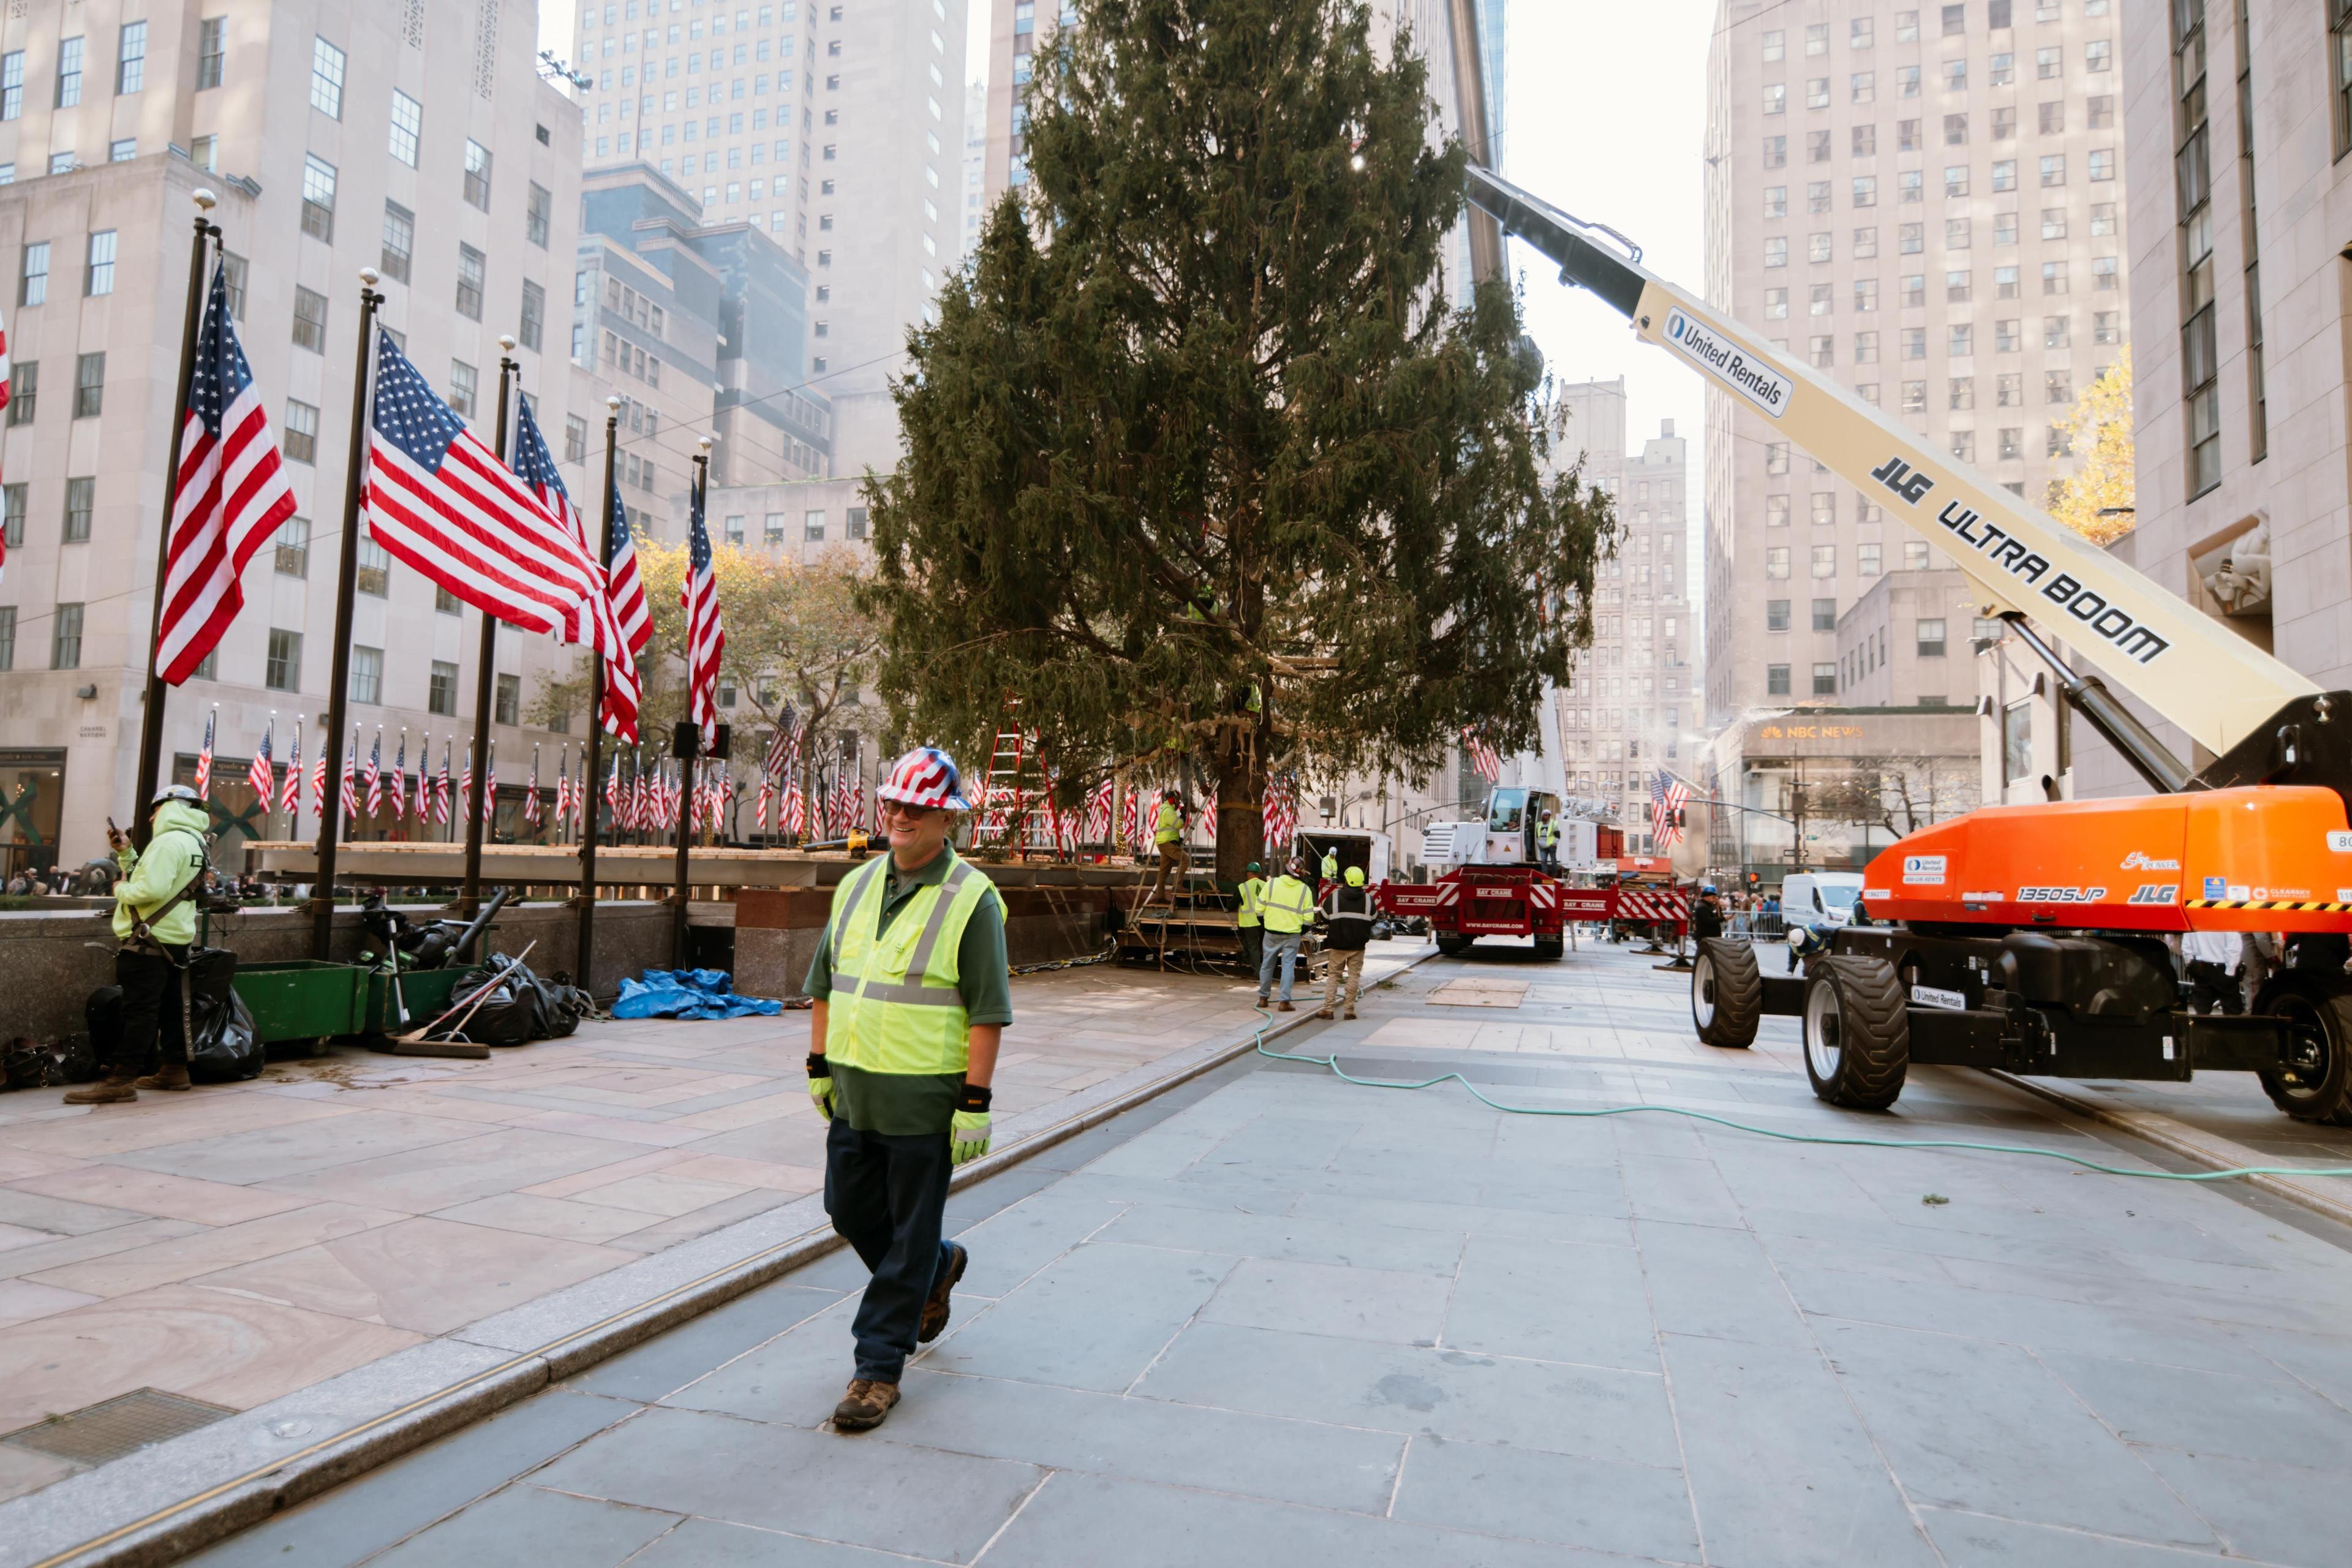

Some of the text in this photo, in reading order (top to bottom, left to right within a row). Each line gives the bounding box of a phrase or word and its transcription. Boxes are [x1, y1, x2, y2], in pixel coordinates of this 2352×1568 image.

[1684, 325, 1781, 405] United Rentals
[1871, 456, 1935, 505] JLG
[1938, 500, 2170, 664] ULTRA BOOM
[1787, 726, 1863, 739] NBC NEWS
[2018, 888, 2104, 902] 1350SJP
[2129, 886, 2177, 903] JLG
[1921, 990, 1961, 1008] United Rentals
